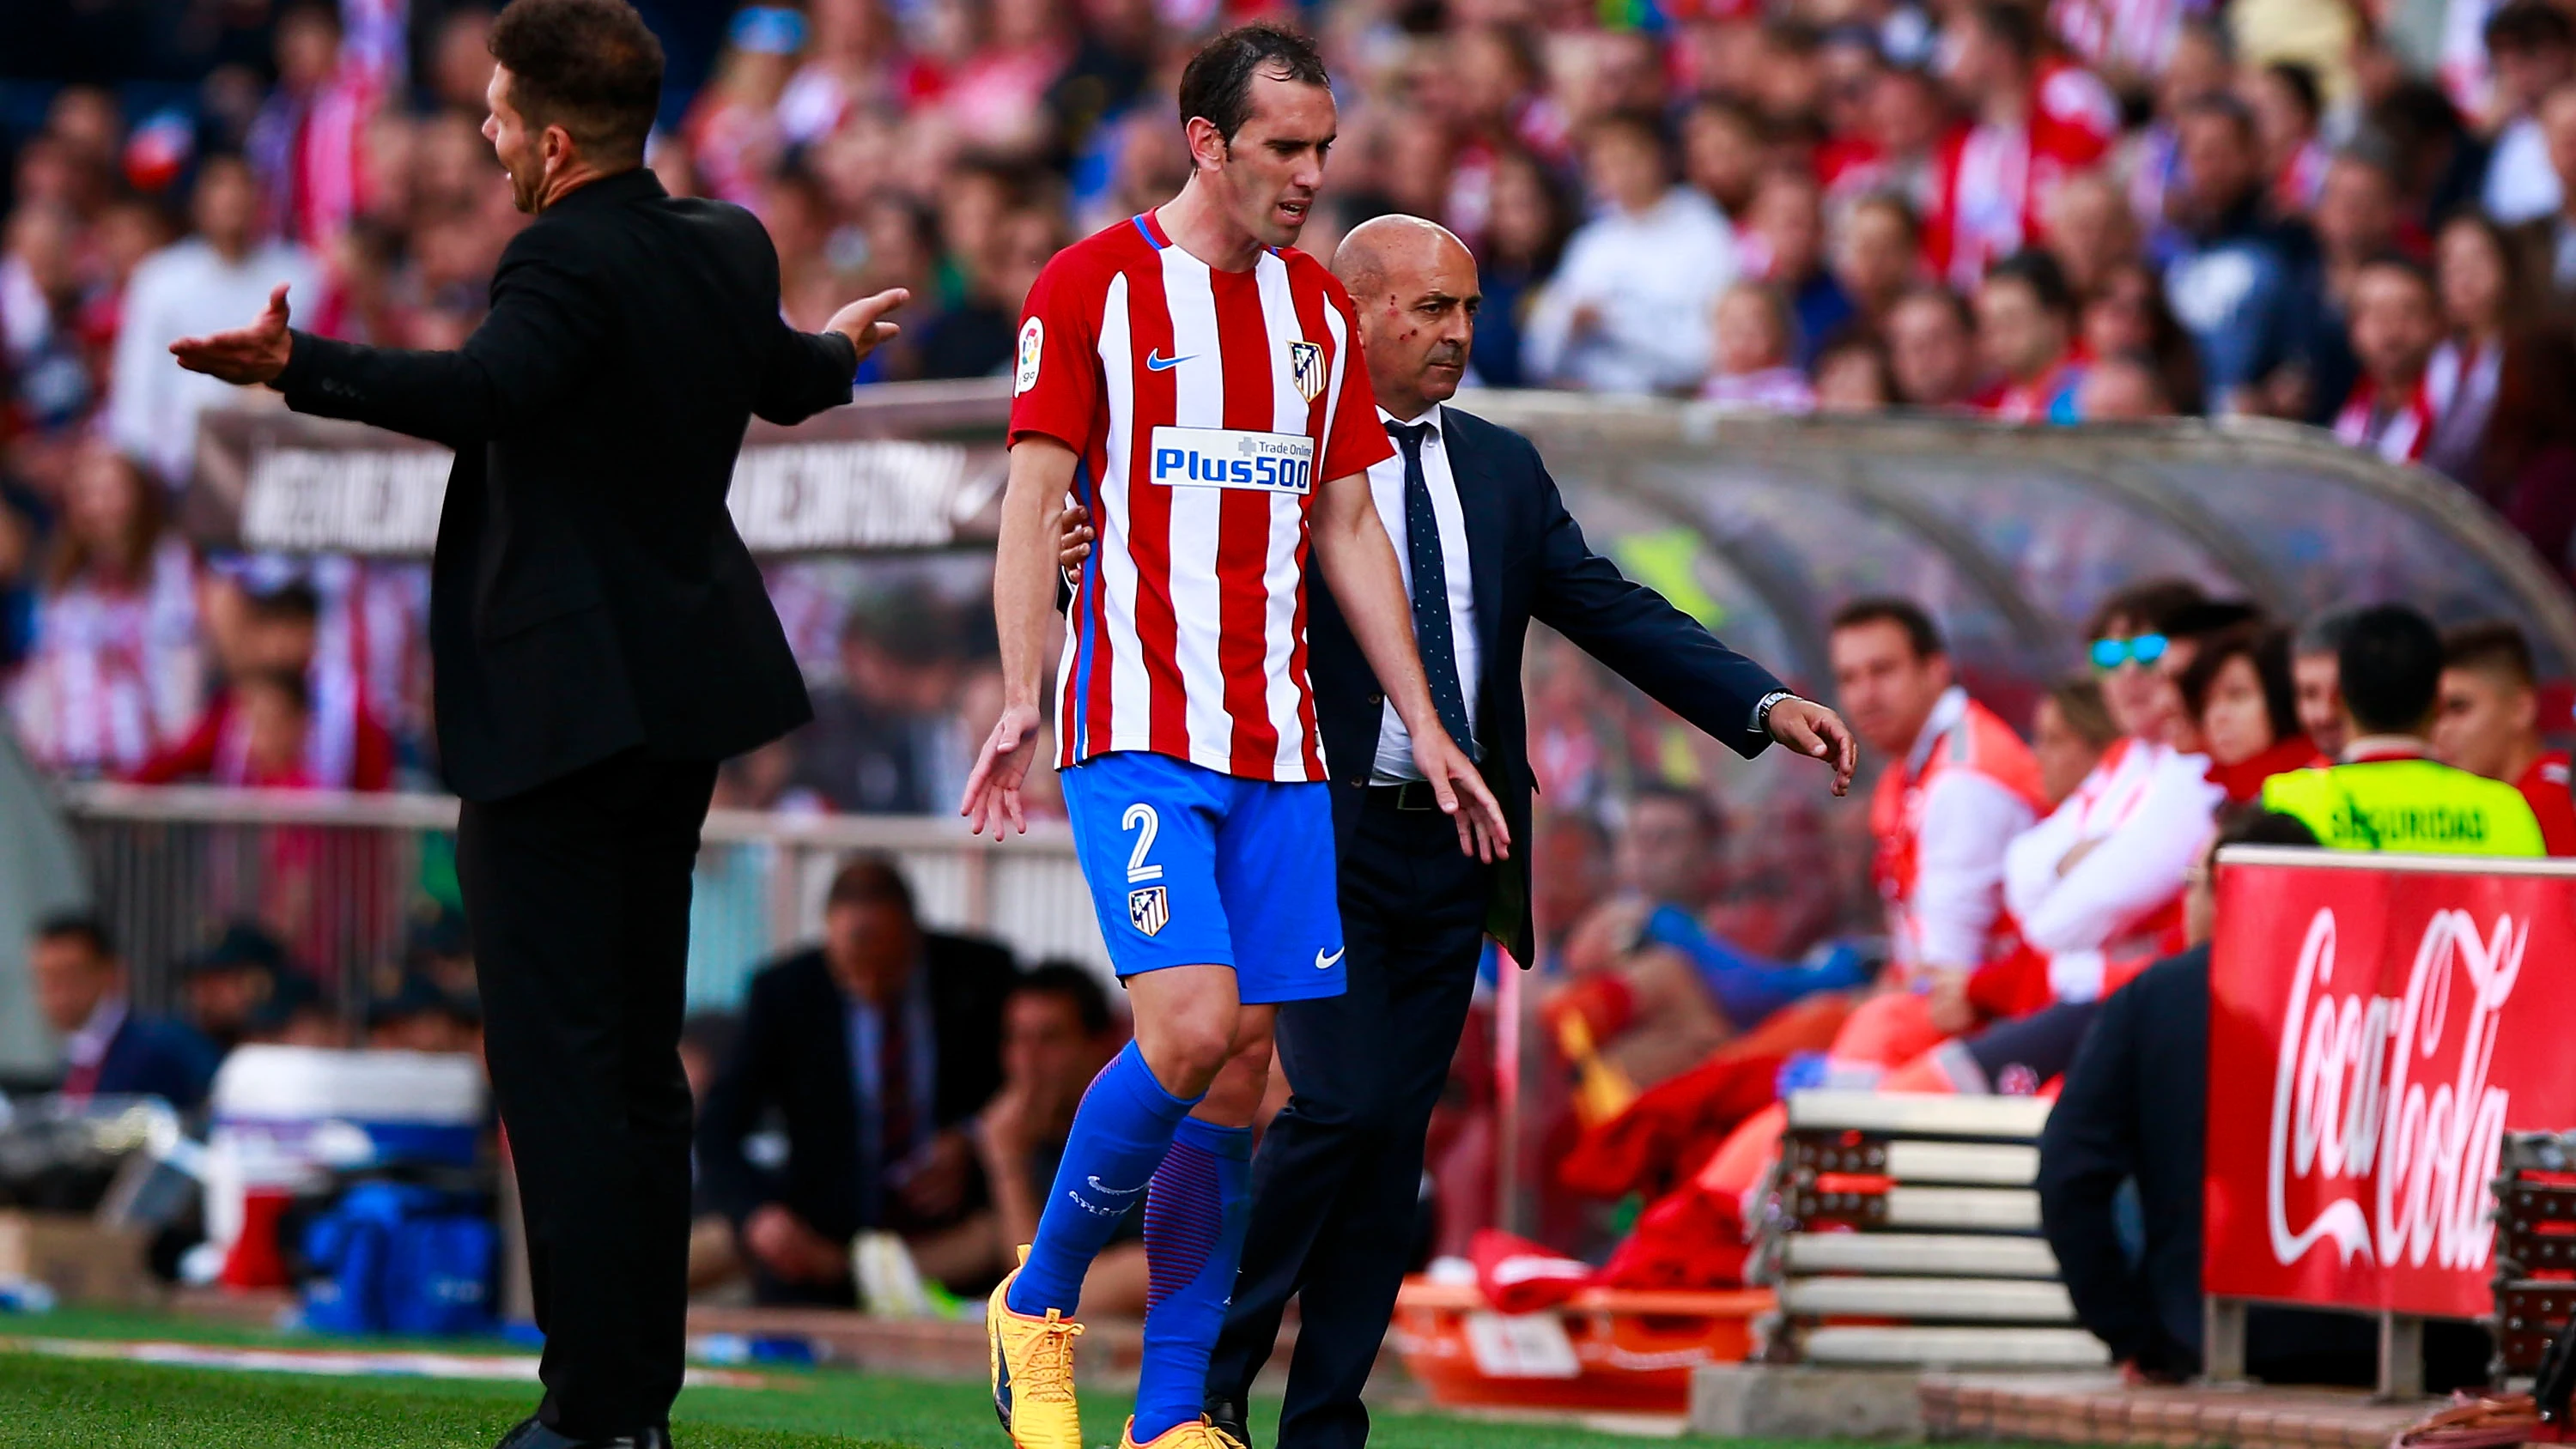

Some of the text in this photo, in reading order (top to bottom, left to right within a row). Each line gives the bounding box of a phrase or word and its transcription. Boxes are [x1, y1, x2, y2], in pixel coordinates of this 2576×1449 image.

[1156, 448, 1309, 488] Plus500
[1259, 440, 1312, 458] Trade Online
[1122, 803, 1163, 884] 2
[2268, 906, 2530, 1270] Coca-Cola
